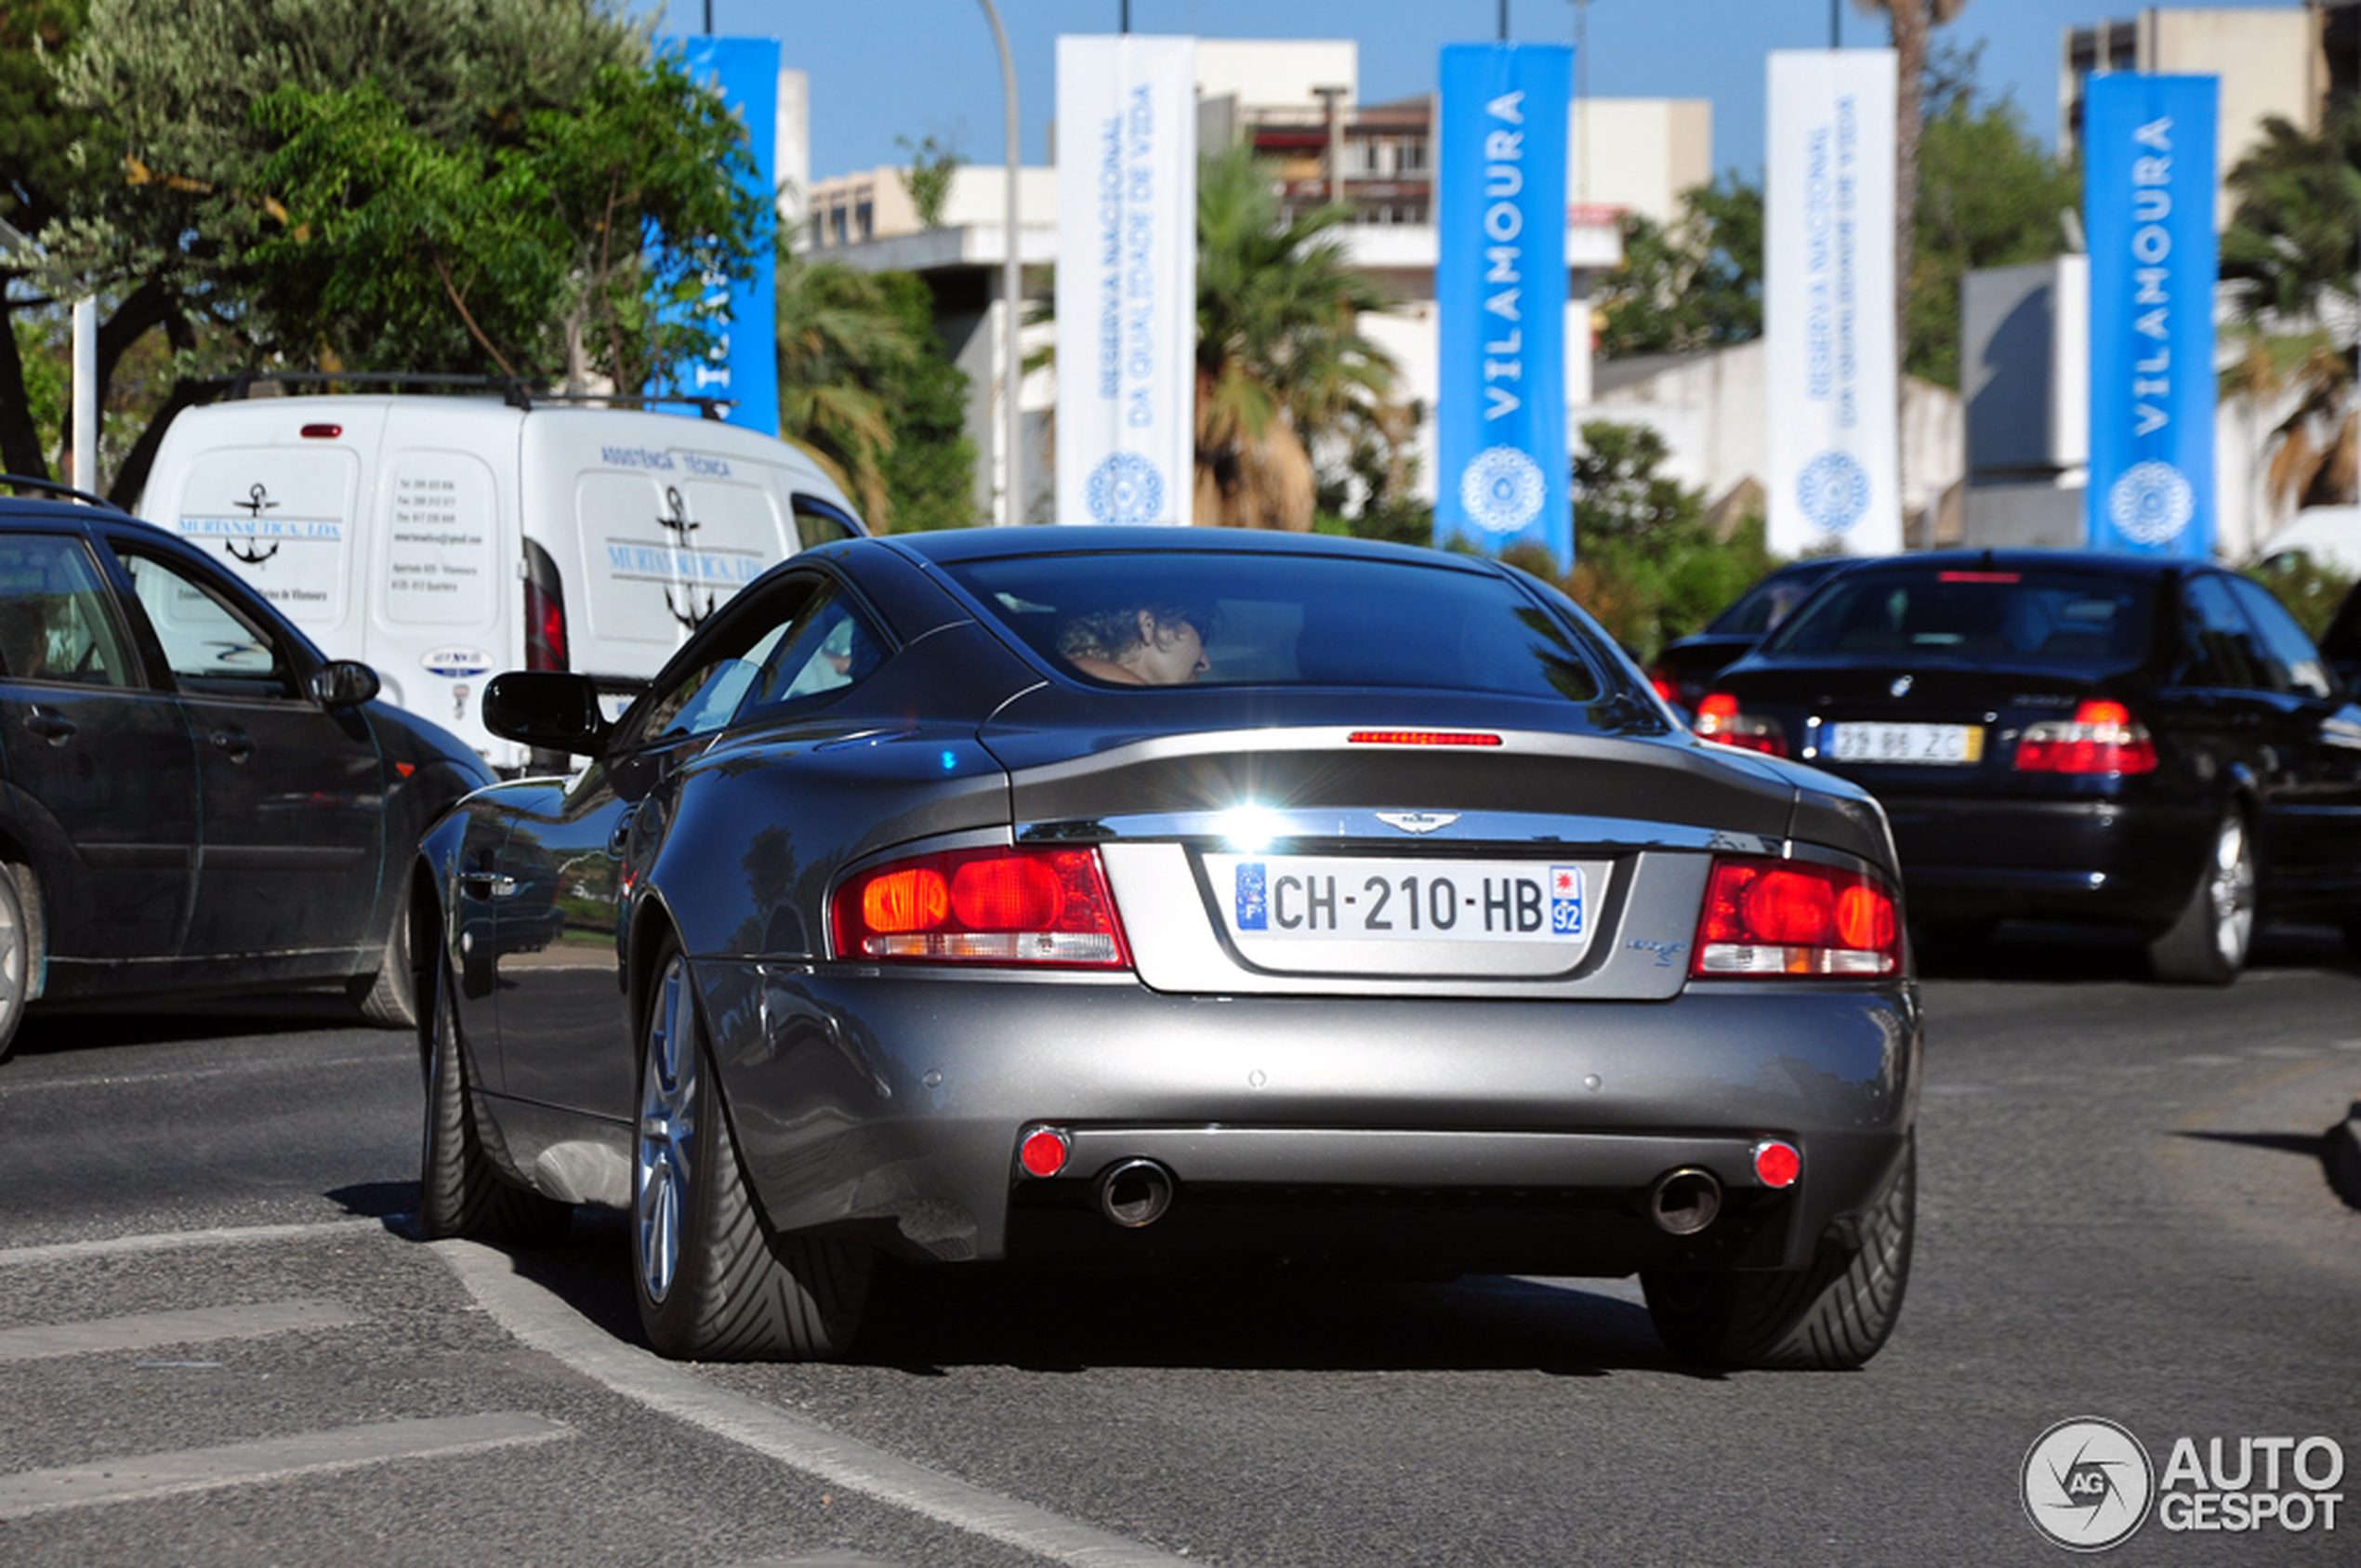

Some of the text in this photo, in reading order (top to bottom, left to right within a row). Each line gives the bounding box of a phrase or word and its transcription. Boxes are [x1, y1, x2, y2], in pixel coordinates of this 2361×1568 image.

[1098, 113, 1124, 401] RESERVA NACIONAL
[1127, 83, 1154, 428] DA QUALIDADE DE VIDA
[1484, 89, 1524, 421] VILAMOURA
[2132, 116, 2174, 437] VILAMOURA
[1273, 875, 1543, 932] CH-210-HB
[1553, 904, 1580, 931] 92
